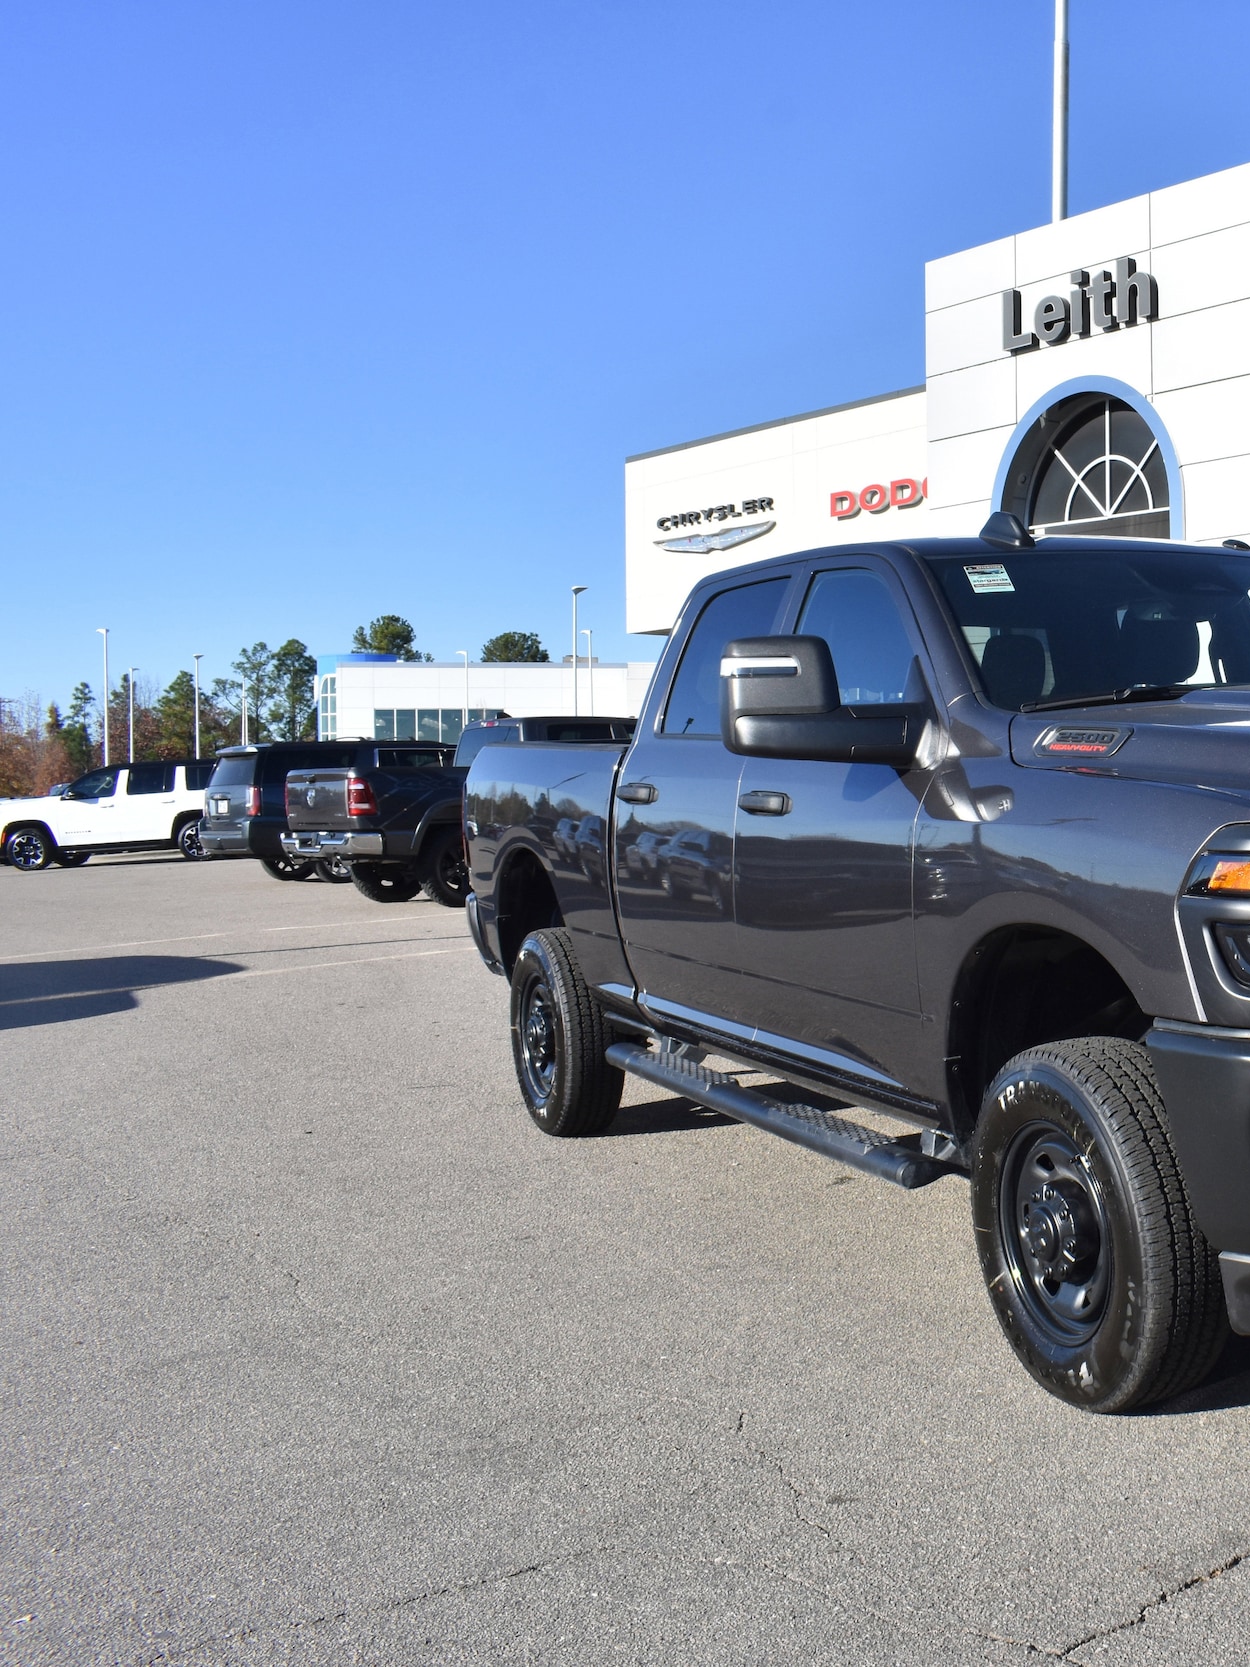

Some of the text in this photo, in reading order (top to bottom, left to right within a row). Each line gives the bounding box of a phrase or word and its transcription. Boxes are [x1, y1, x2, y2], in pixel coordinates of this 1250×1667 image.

[1003, 257, 1157, 354] Leith
[657, 497, 774, 531] CHRYSLER
[830, 478, 928, 520] DOD
[1056, 731, 1116, 743] 2500
